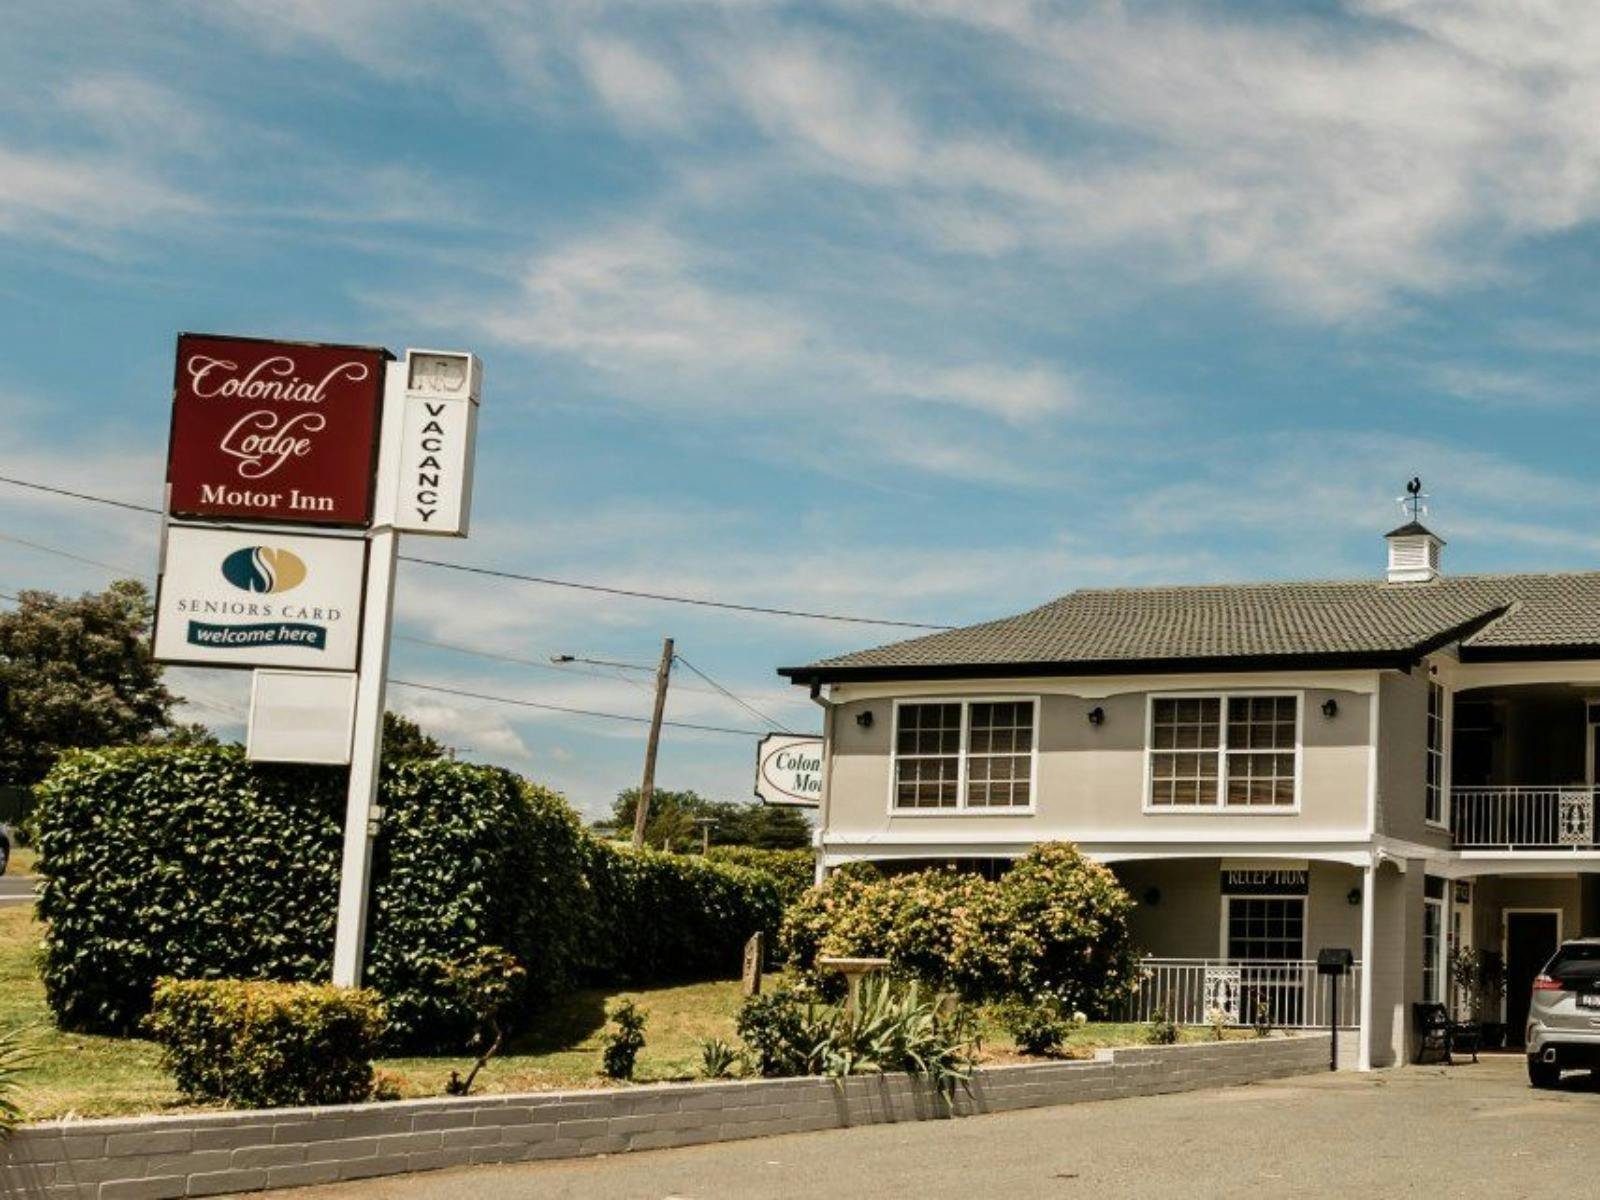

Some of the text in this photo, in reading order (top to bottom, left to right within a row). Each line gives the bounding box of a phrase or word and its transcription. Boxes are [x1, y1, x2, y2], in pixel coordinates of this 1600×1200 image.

[187, 355, 368, 403] Colonial
[220, 410, 326, 478] Lodge
[416, 402, 446, 523] VACANCY
[200, 483, 335, 512] Motor Inn
[177, 599, 342, 622] SENIORS CARD
[196, 625, 318, 644] welcome here
[1229, 870, 1306, 885] RECEPTION
